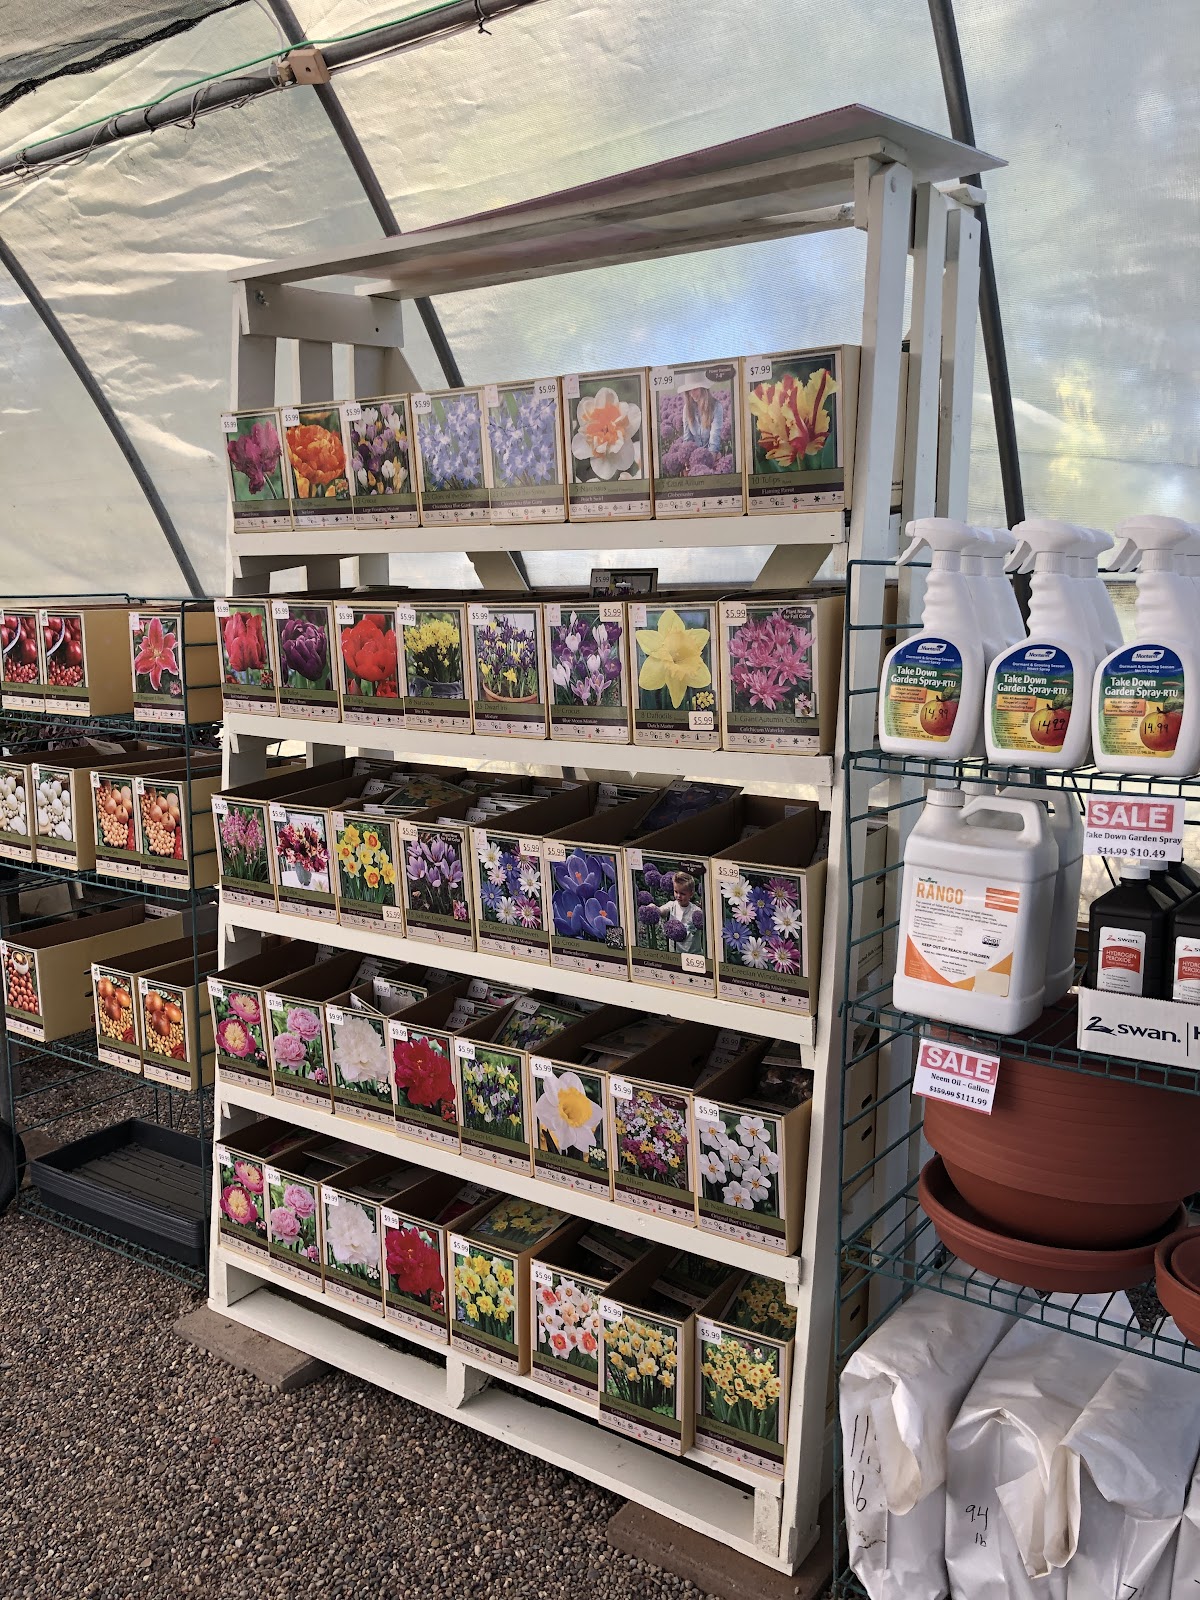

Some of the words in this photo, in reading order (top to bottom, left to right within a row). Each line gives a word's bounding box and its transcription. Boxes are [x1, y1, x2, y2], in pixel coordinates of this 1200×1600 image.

[750, 365, 771, 376] $7.99
[654, 376, 672, 386] $7.99
[538, 384, 556, 394] $5.99
[414, 400, 430, 408] $5.99
[346, 408, 361, 417] $5.99
[284, 414, 299, 422] $5.99
[224, 421, 237, 430] $5.99
[339, 612, 353, 620] $5.99
[472, 612, 488, 620] $5.99
[603, 608, 622, 618] $5.99
[726, 608, 746, 618] $5.99
[897, 666, 915, 676] Take
[916, 667, 937, 677] Down
[891, 675, 918, 684] Garden
[918, 676, 956, 688] Spray-RTU
[1004, 674, 1022, 684] Take
[1023, 675, 1047, 685] Down
[1110, 677, 1130, 687] Take
[1131, 678, 1157, 687] Down
[997, 683, 1026, 693] Garden
[1027, 684, 1068, 696] Spray-RTU
[1105, 686, 1135, 696] Garden
[1136, 687, 1178, 698] Spray-RTU
[646, 711, 672, 720] Daffodils
[924, 707, 948, 720] 14.99
[693, 716, 713, 726] $5.99
[740, 715, 757, 723] Giant
[758, 716, 784, 724] Autumn
[214, 802, 227, 810] $5.99
[272, 810, 286, 818] $5.99
[1090, 804, 1168, 829] SALE
[402, 827, 417, 836] $5.99
[1104, 832, 1127, 841] Down
[1129, 833, 1157, 843] Garden
[1159, 834, 1182, 846] Spray
[523, 844, 540, 852] $5.99
[548, 847, 564, 856] $5.99
[1097, 846, 1128, 856] $14.99
[1130, 848, 1166, 859] $10.49
[718, 866, 739, 877] $5.99
[916, 882, 964, 905] RANGO
[386, 910, 400, 919] $5.99
[969, 951, 990, 960] CHILDREN
[1105, 956, 1132, 964] PEROXIDE
[1106, 950, 1137, 960] HYDROGEN
[686, 957, 704, 968] $6.99
[731, 966, 756, 976] Grecian
[757, 971, 797, 985] Windflowers
[210, 986, 223, 994] $9.99
[268, 999, 282, 1008] $7.99
[520, 1002, 537, 1010] $5.99
[328, 1011, 343, 1021] $9.99
[450, 1017, 465, 1026] $9.99
[392, 1026, 407, 1037] $9.99
[458, 1045, 474, 1056] $5.99
[534, 1062, 552, 1073] $5.99
[926, 1046, 993, 1081] SALE
[614, 1082, 632, 1094] $5.99
[931, 1072, 950, 1084] Neem
[951, 1078, 961, 1086] Oil
[967, 1082, 990, 1094] Gallon
[929, 1085, 955, 1097] $159.99
[955, 1091, 988, 1106] $111.99
[698, 1105, 718, 1117] $5.99
[267, 1172, 280, 1182] $7.99
[324, 1193, 338, 1203] $9.99
[710, 1203, 739, 1215] Narcissus
[384, 1214, 398, 1225] $9.99
[452, 1242, 468, 1253] $5.99
[535, 1271, 552, 1282] $5.99
[603, 1304, 622, 1316] $5.99
[700, 1328, 720, 1341] $5.99
